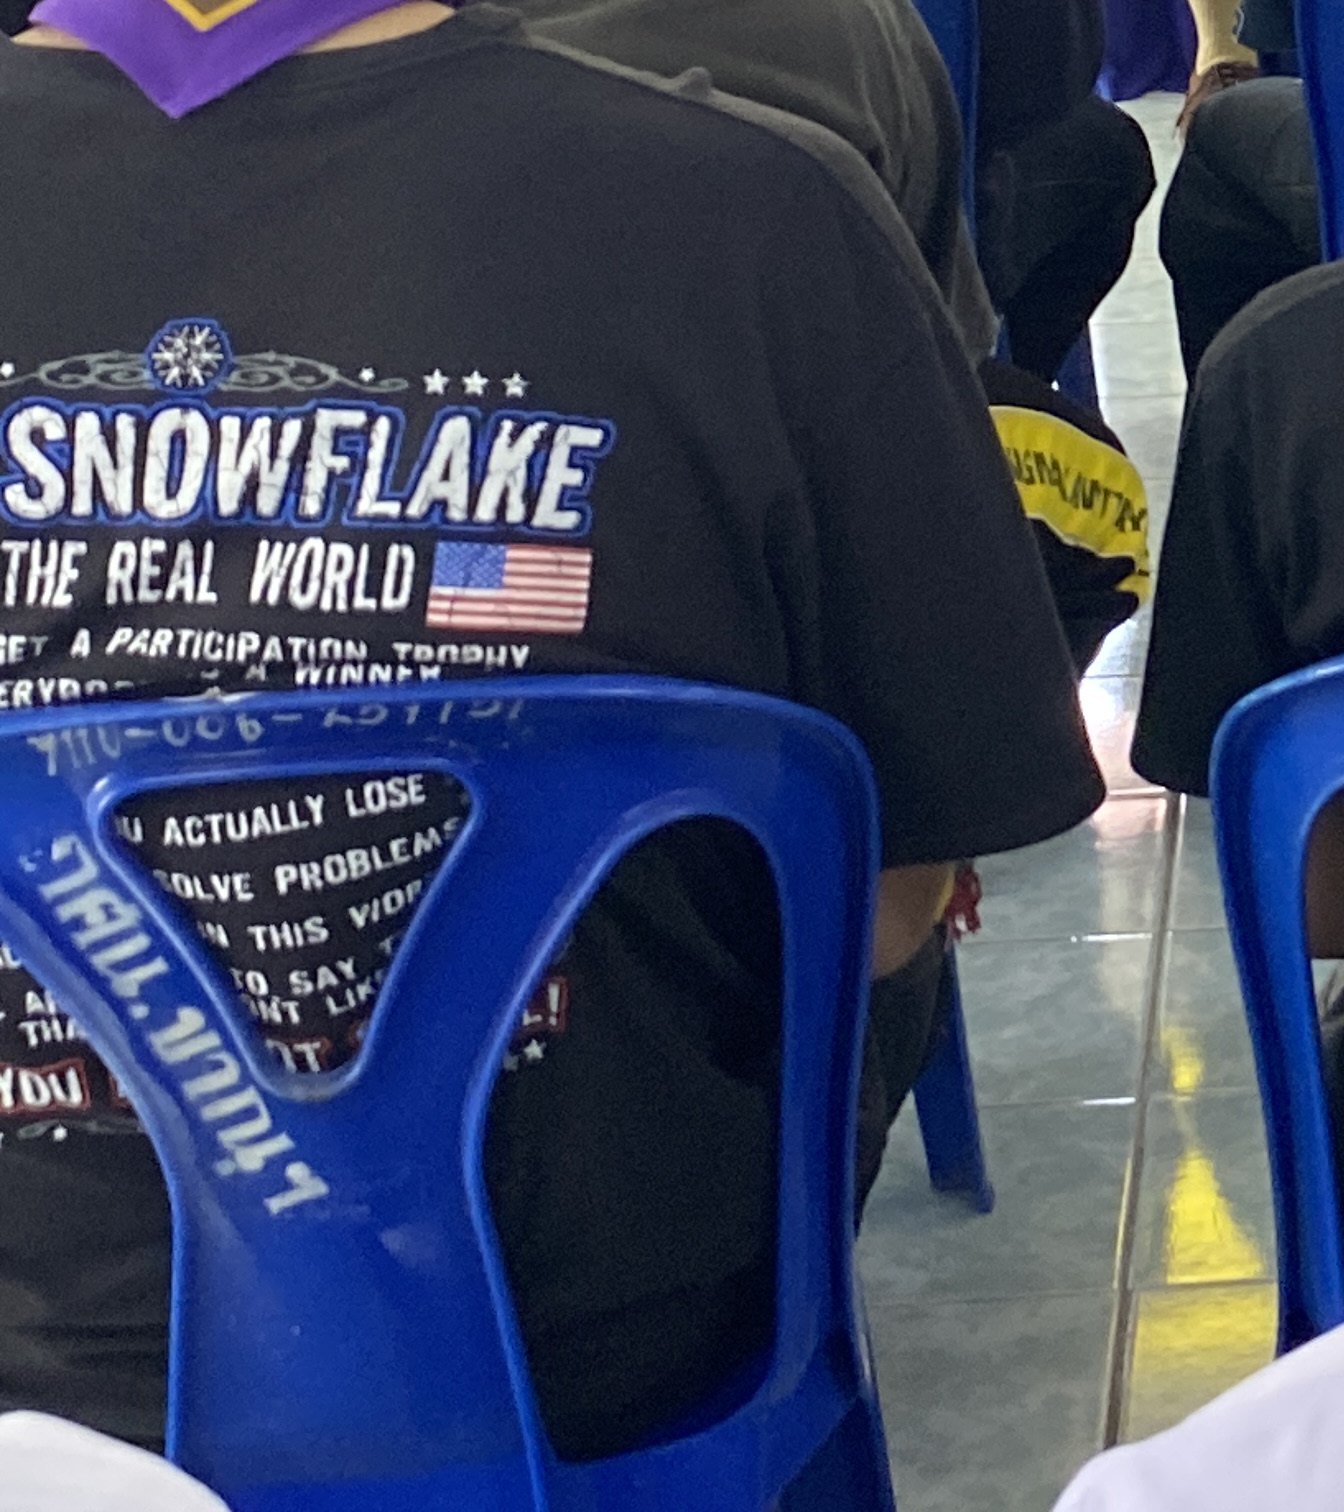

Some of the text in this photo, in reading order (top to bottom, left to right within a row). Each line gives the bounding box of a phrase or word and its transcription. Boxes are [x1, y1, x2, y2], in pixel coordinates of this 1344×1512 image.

[4, 401, 605, 531] SNOWFLAKE
[0, 537, 417, 612] THE REAL WORLD
[69, 626, 92, 660] A
[105, 626, 369, 666] PARTICIPATION
[163, 793, 325, 848] ACTUALLY
[344, 773, 427, 819] LOSE
[246, 915, 329, 952] THIS
[288, 955, 358, 997] SAY
